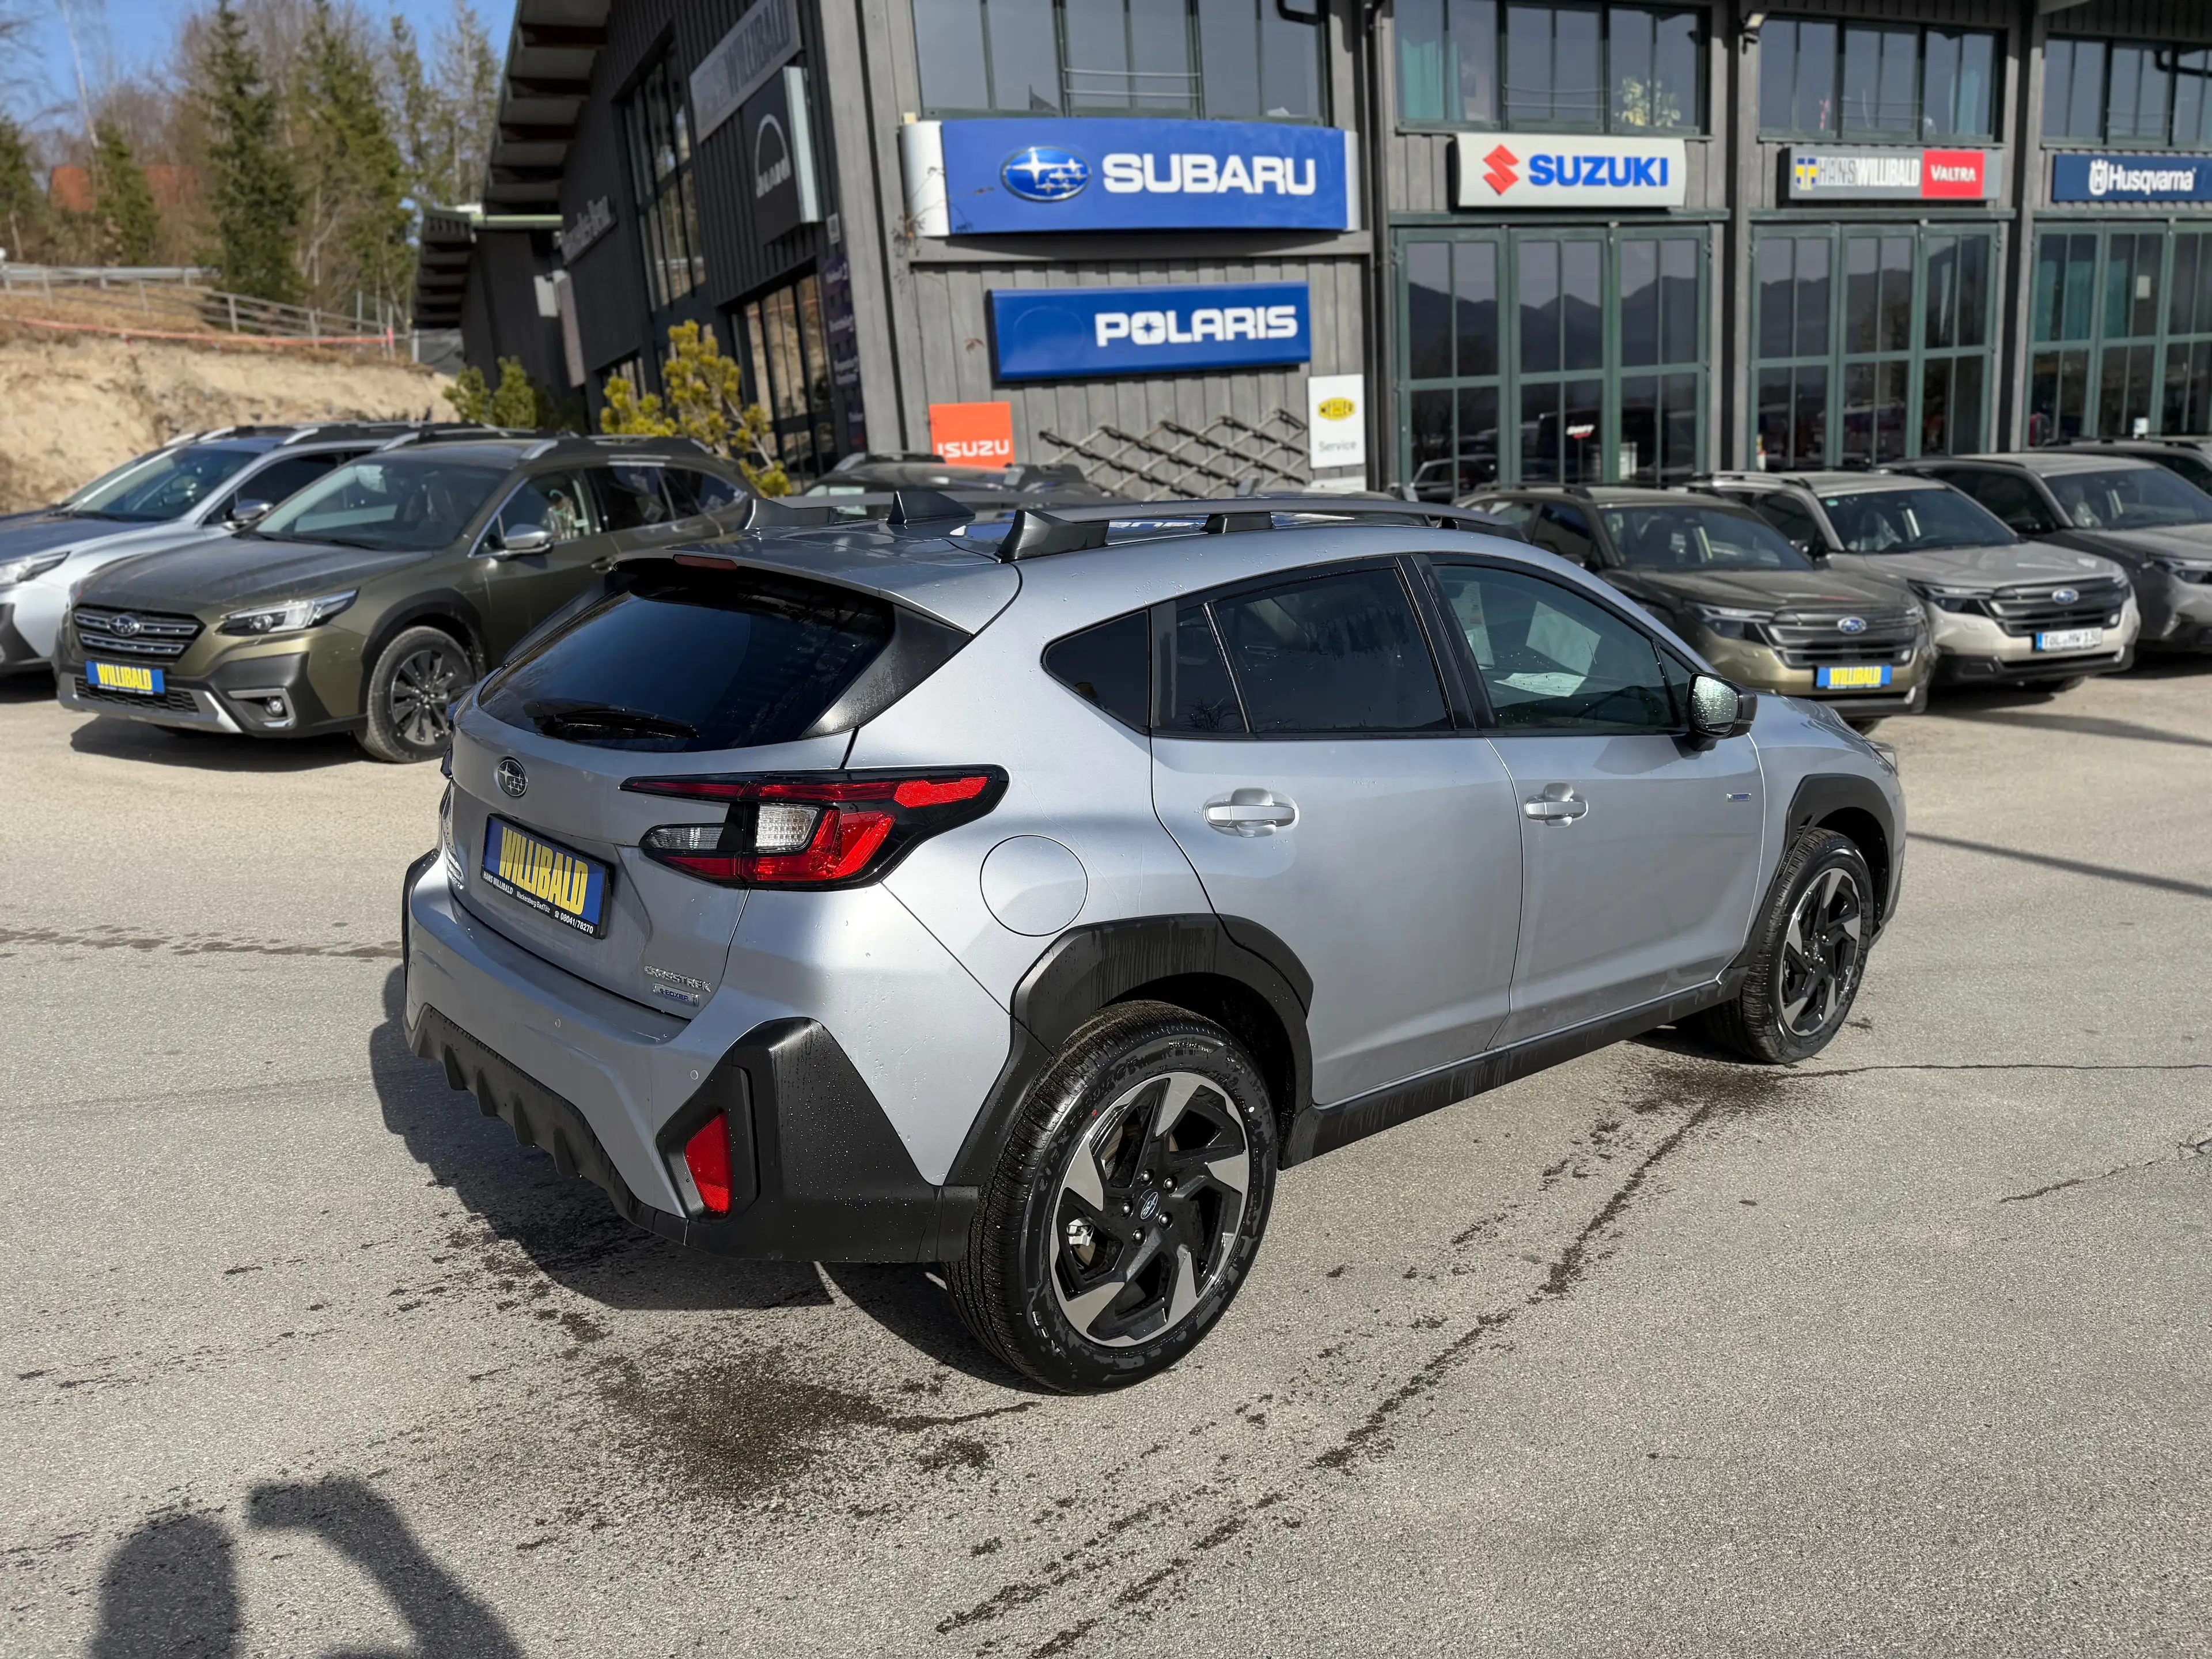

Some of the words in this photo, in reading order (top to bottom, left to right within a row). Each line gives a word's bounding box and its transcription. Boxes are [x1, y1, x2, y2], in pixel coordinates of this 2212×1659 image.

[1102, 153, 1316, 196] SUBARU
[1528, 154, 1668, 187] SUZUKI
[1930, 164, 1976, 182] VALTRA
[2108, 164, 2194, 195] Husqvarna
[1094, 305, 1298, 347] POLARIS
[937, 438, 1010, 459] ISUZU
[1318, 439, 1357, 453] Service
[96, 663, 153, 691] WILLIBALD
[1830, 666, 1881, 685] WILLIBALD
[499, 826, 588, 915] WILLIBALD
[483, 871, 493, 883] HANS
[493, 877, 513, 895] WILLIBALD
[560, 912, 593, 934] 08041/78270
